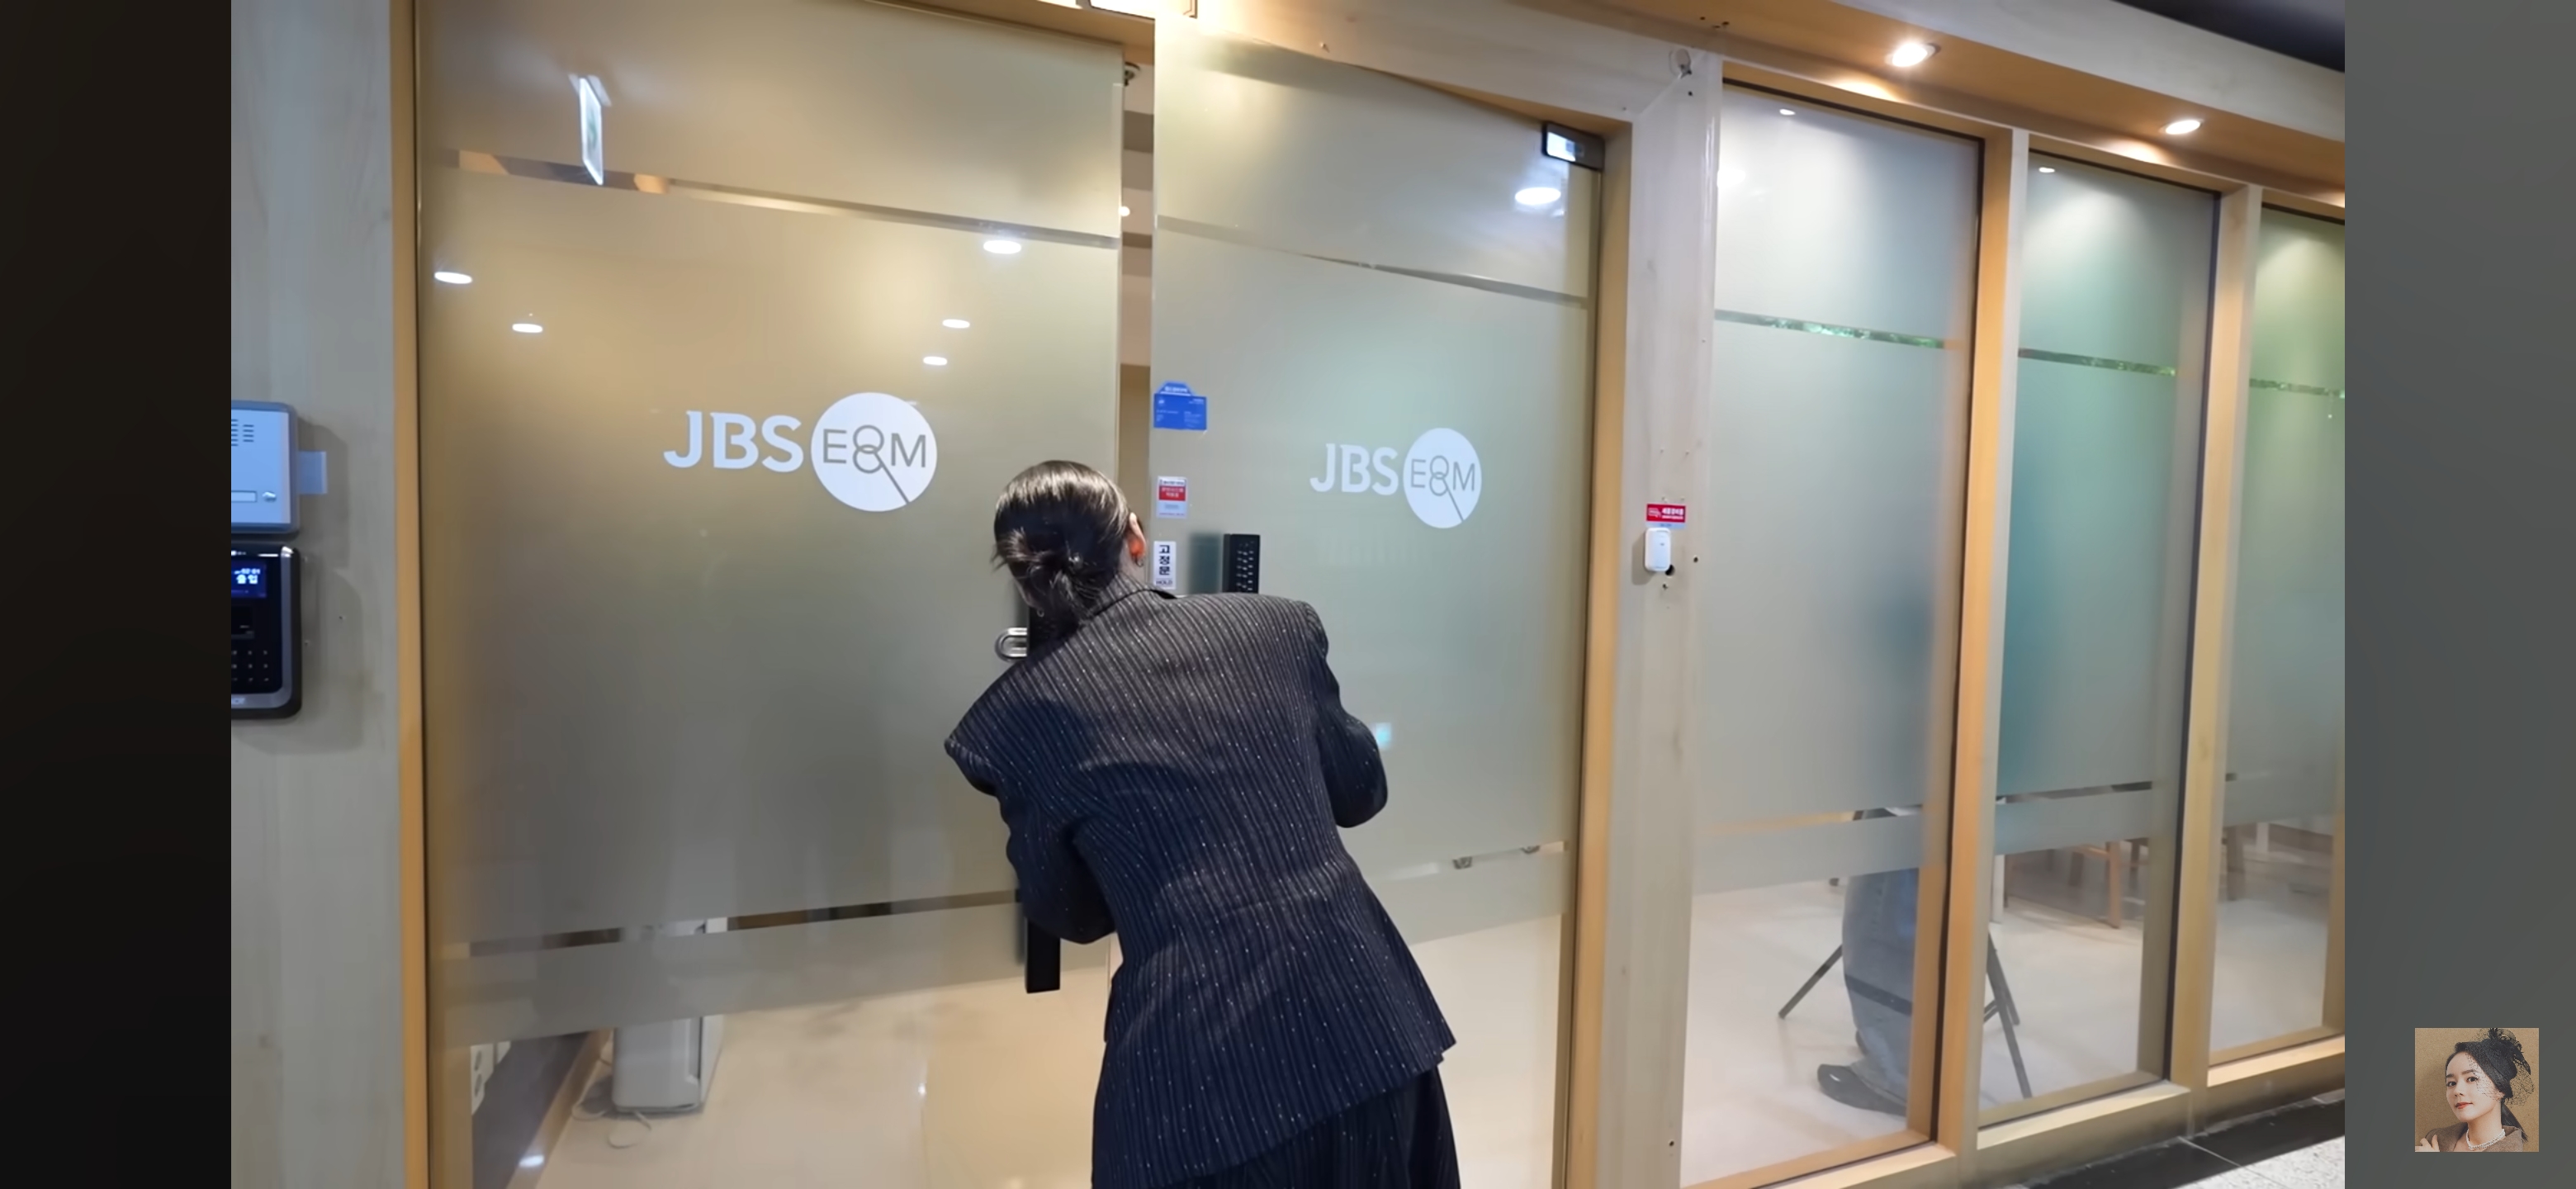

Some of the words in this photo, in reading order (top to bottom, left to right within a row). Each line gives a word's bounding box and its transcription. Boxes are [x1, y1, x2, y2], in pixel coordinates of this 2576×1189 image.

[663, 410, 803, 472] JBS
[1309, 443, 1399, 495] JBS
[1158, 544, 1170, 576] 고정문
